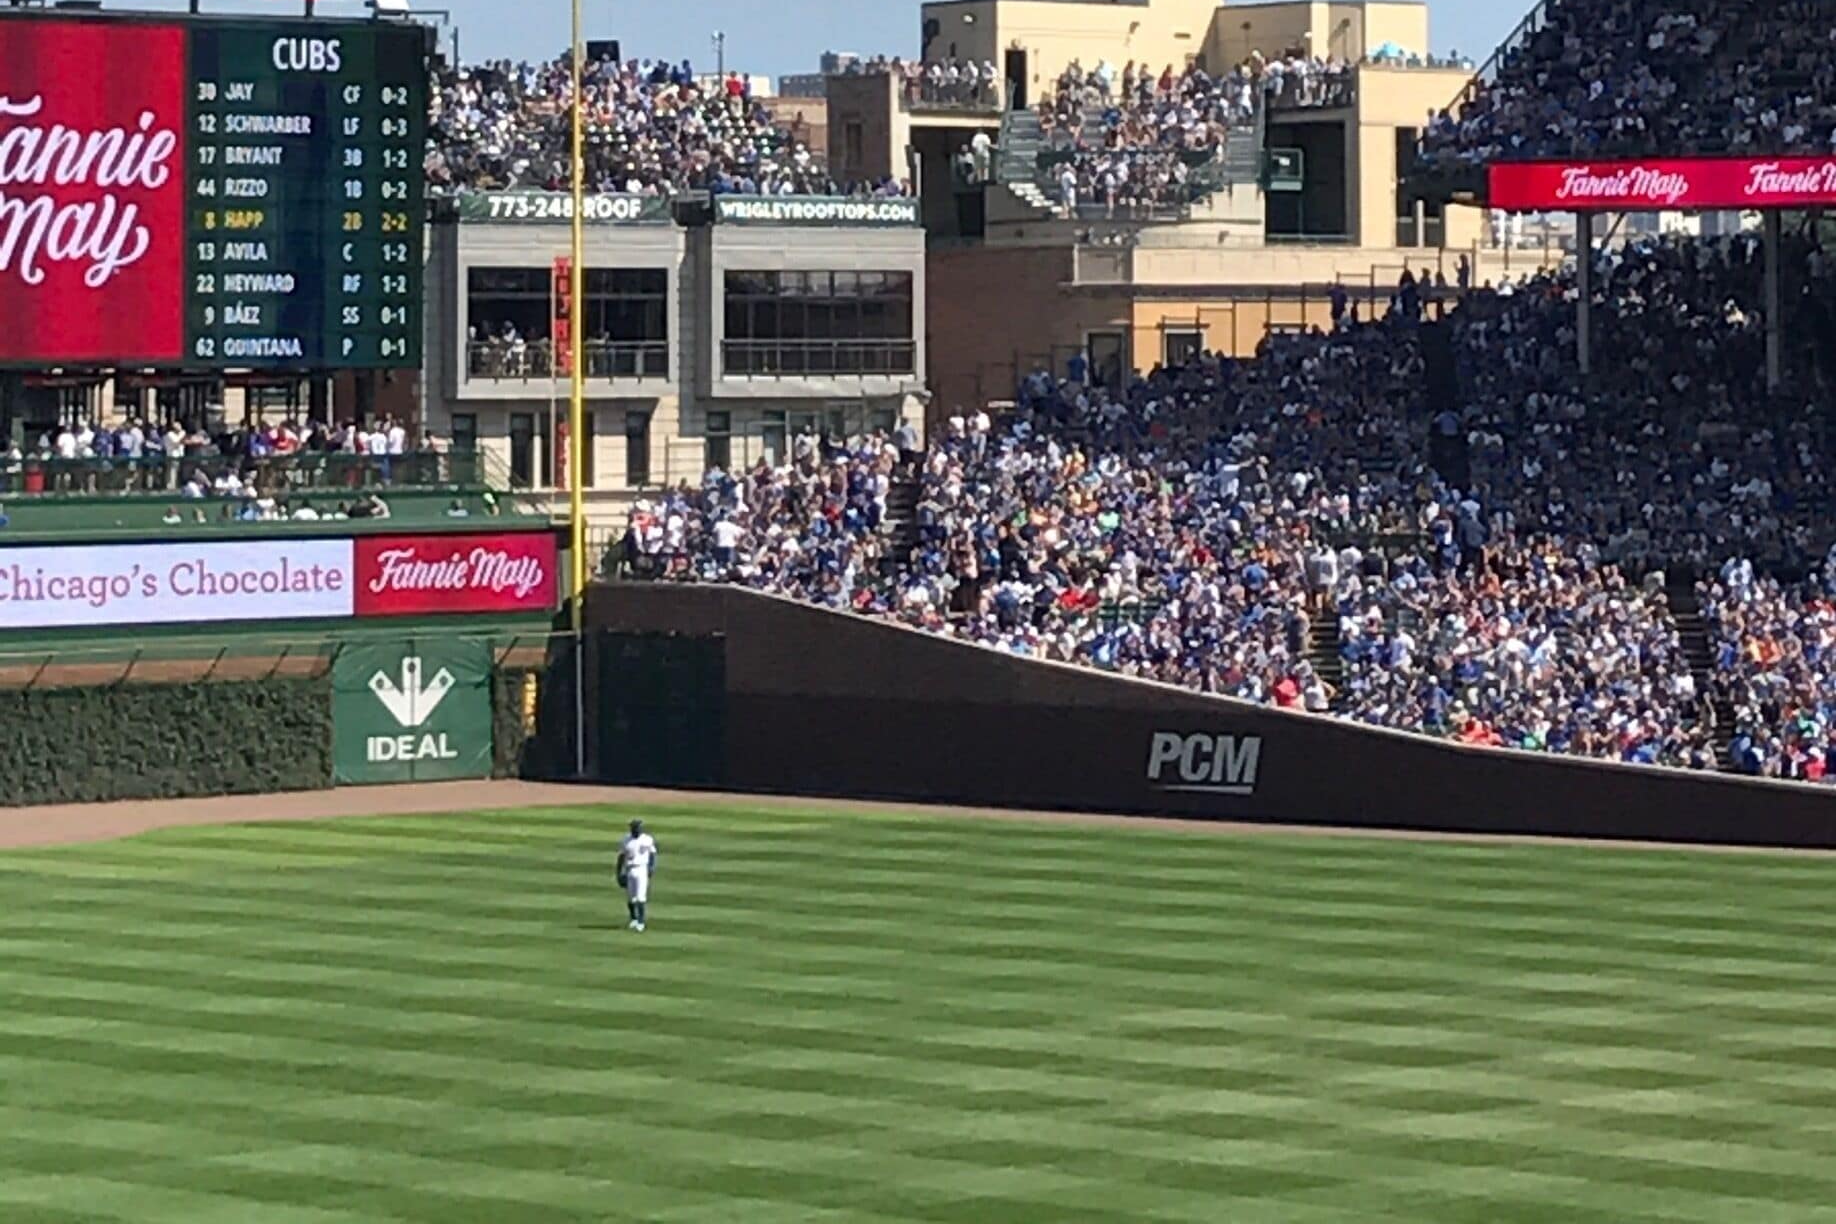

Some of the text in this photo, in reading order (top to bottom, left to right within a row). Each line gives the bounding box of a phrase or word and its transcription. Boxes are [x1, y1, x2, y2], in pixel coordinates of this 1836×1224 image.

[272, 37, 341, 72] CUBS
[224, 82, 254, 101] JAY
[343, 85, 361, 105] CF
[381, 86, 408, 105] 0-2
[198, 113, 407, 137] 12 SCHWARBER LF 0-3
[0, 95, 176, 188] annie
[198, 146, 407, 168] 17 BRYANT 3B 1-2
[196, 177, 407, 199] 44 RIZZO 1B 0-2
[1556, 166, 1688, 204] Fannie May
[1744, 162, 1819, 195] Fannie
[223, 210, 264, 229] HAPP
[342, 212, 362, 231] 2B
[381, 212, 407, 231] 2-2
[720, 202, 914, 221] WRIGLEYROOFTOPS.COM
[197, 241, 407, 262] 13 AVILA C 1-2
[196, 273, 406, 293] 22 HEYWARD RF 1-2
[204, 306, 215, 325] 9
[342, 306, 360, 325] SS
[381, 306, 406, 325] 0-1
[195, 337, 406, 357] 62 QUINTANA P 0-1
[169, 557, 343, 596] Chocolate
[369, 547, 543, 598] Fannie May
[367, 733, 458, 761] IDEAL
[1148, 732, 1261, 784] PCM
